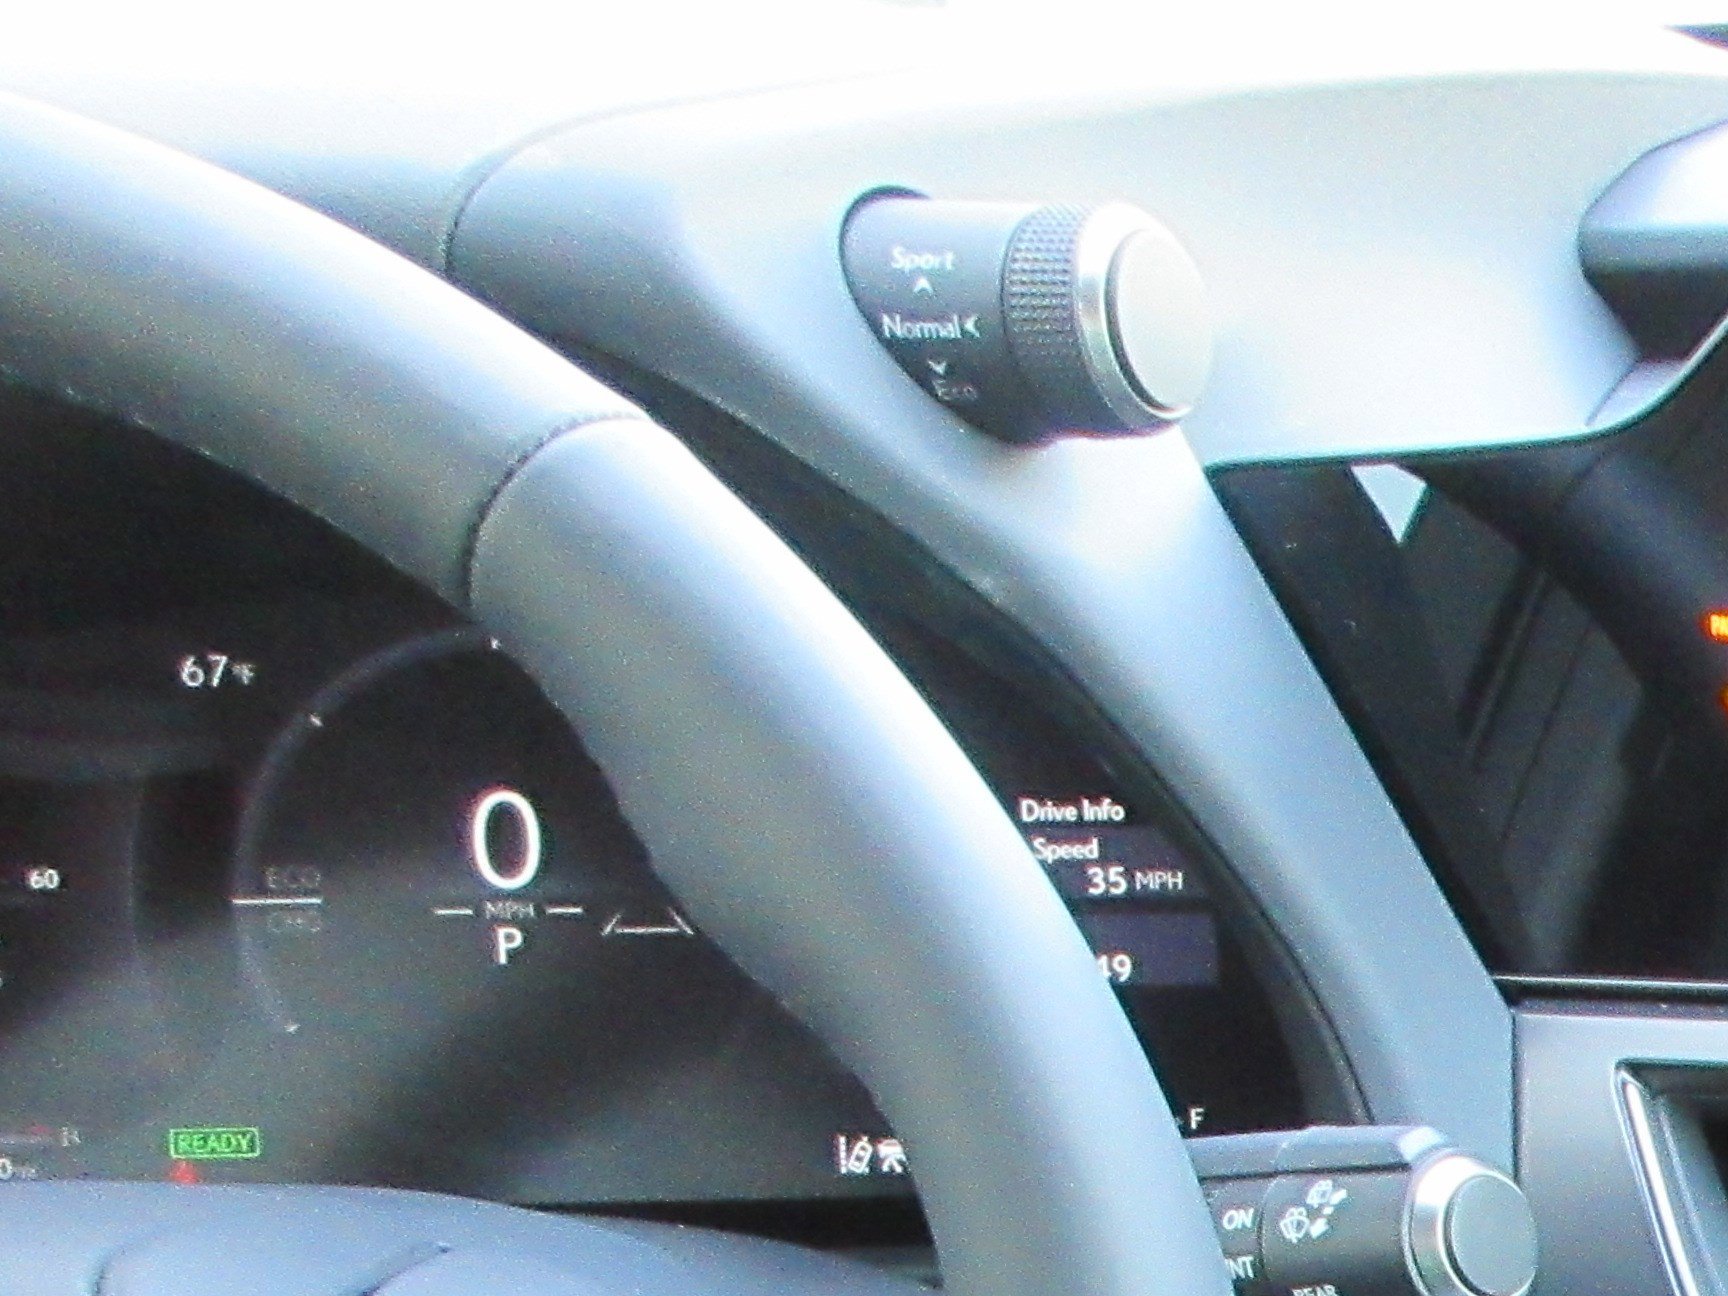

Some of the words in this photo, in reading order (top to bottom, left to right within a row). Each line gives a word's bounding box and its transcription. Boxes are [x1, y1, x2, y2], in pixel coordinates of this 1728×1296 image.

[890, 246, 956, 274] Sport
[882, 312, 961, 340] Normal
[1021, 797, 1078, 823] Drive
[1082, 796, 1126, 823] Info
[472, 790, 542, 890] 0
[1030, 836, 1100, 864] Speed
[25, 867, 60, 890] 60
[1085, 866, 1128, 896] 35
[1134, 870, 1183, 891] MPH
[495, 926, 525, 966] P
[176, 1133, 252, 1153] READY
[1222, 1208, 1255, 1230] ON
[1223, 1255, 1255, 1279] NT
